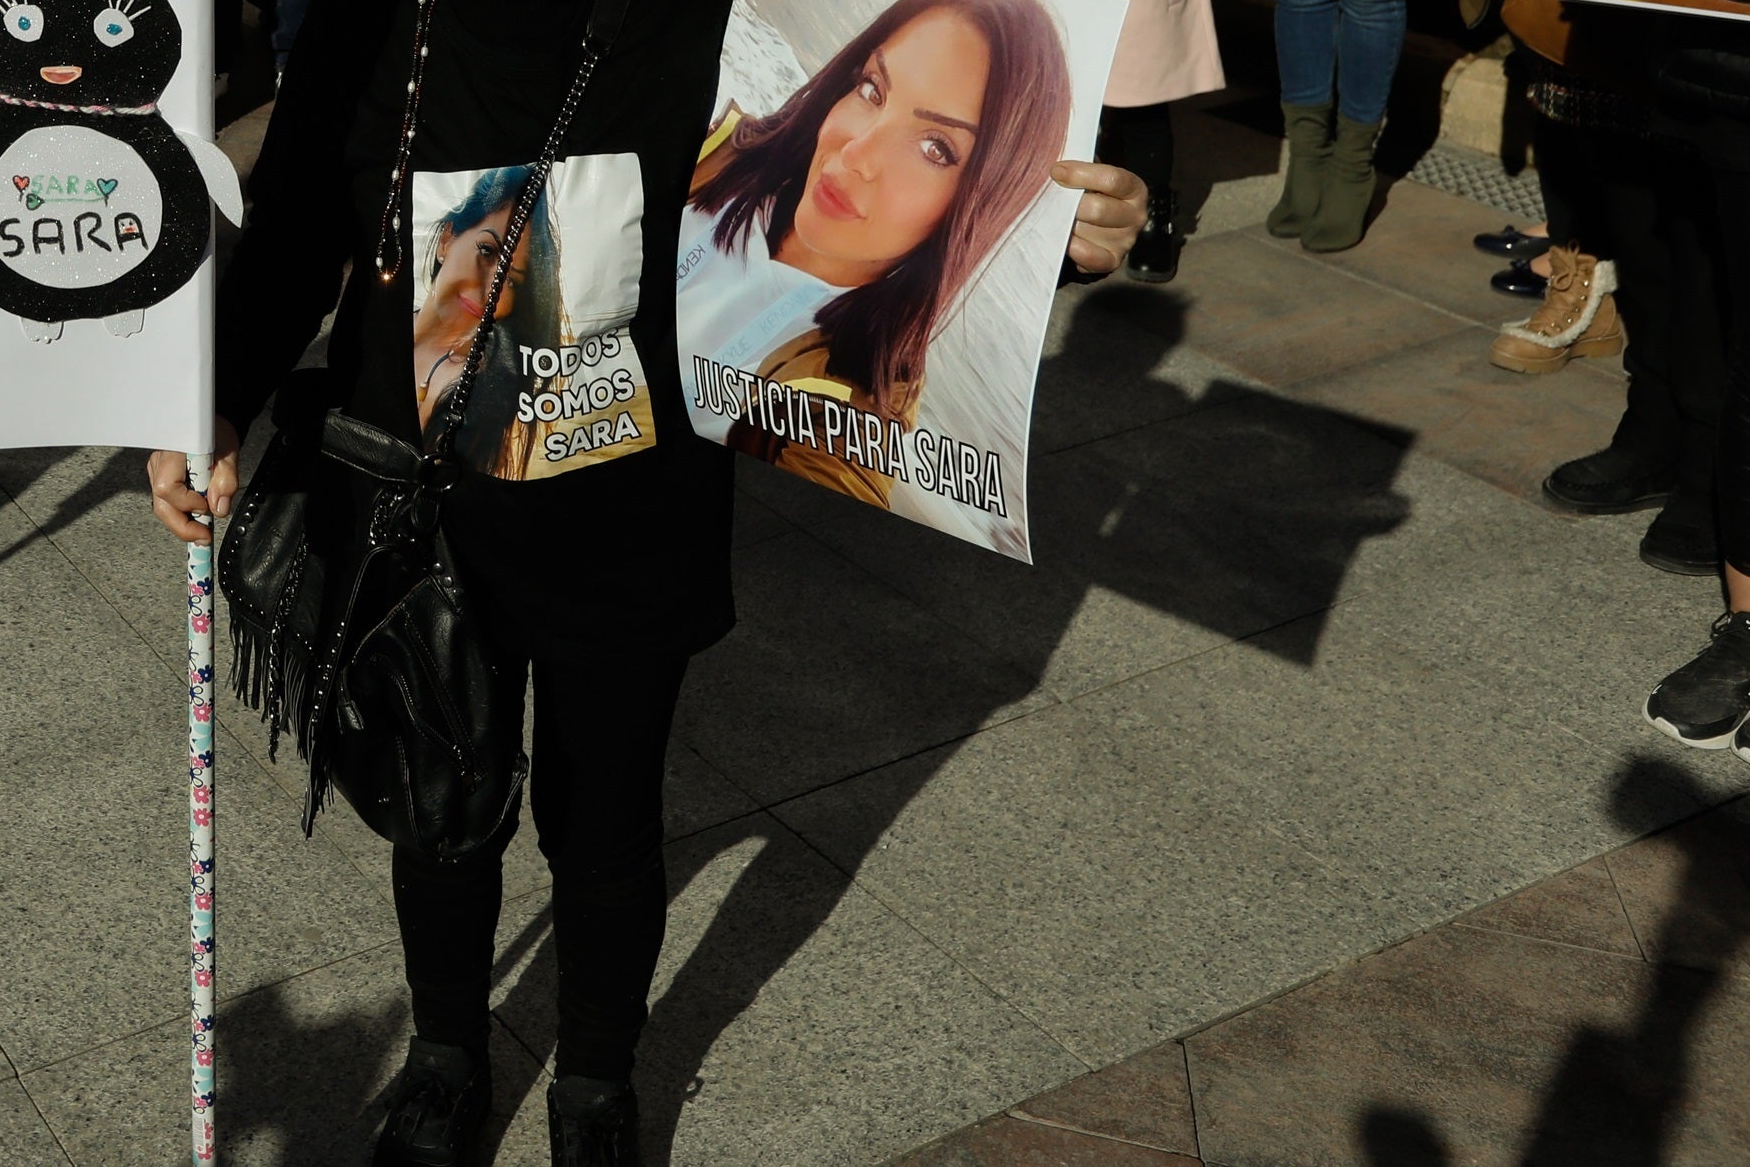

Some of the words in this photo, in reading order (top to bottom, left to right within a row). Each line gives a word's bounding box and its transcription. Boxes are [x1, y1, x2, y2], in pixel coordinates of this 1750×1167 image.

[31, 174, 102, 198] SARA
[518, 327, 621, 380] TODOS
[516, 368, 636, 424] SOMOS
[544, 411, 642, 463] SARA
[691, 355, 819, 452] JUSTICIA
[822, 398, 910, 484] PARA
[912, 428, 1009, 519] SARA
